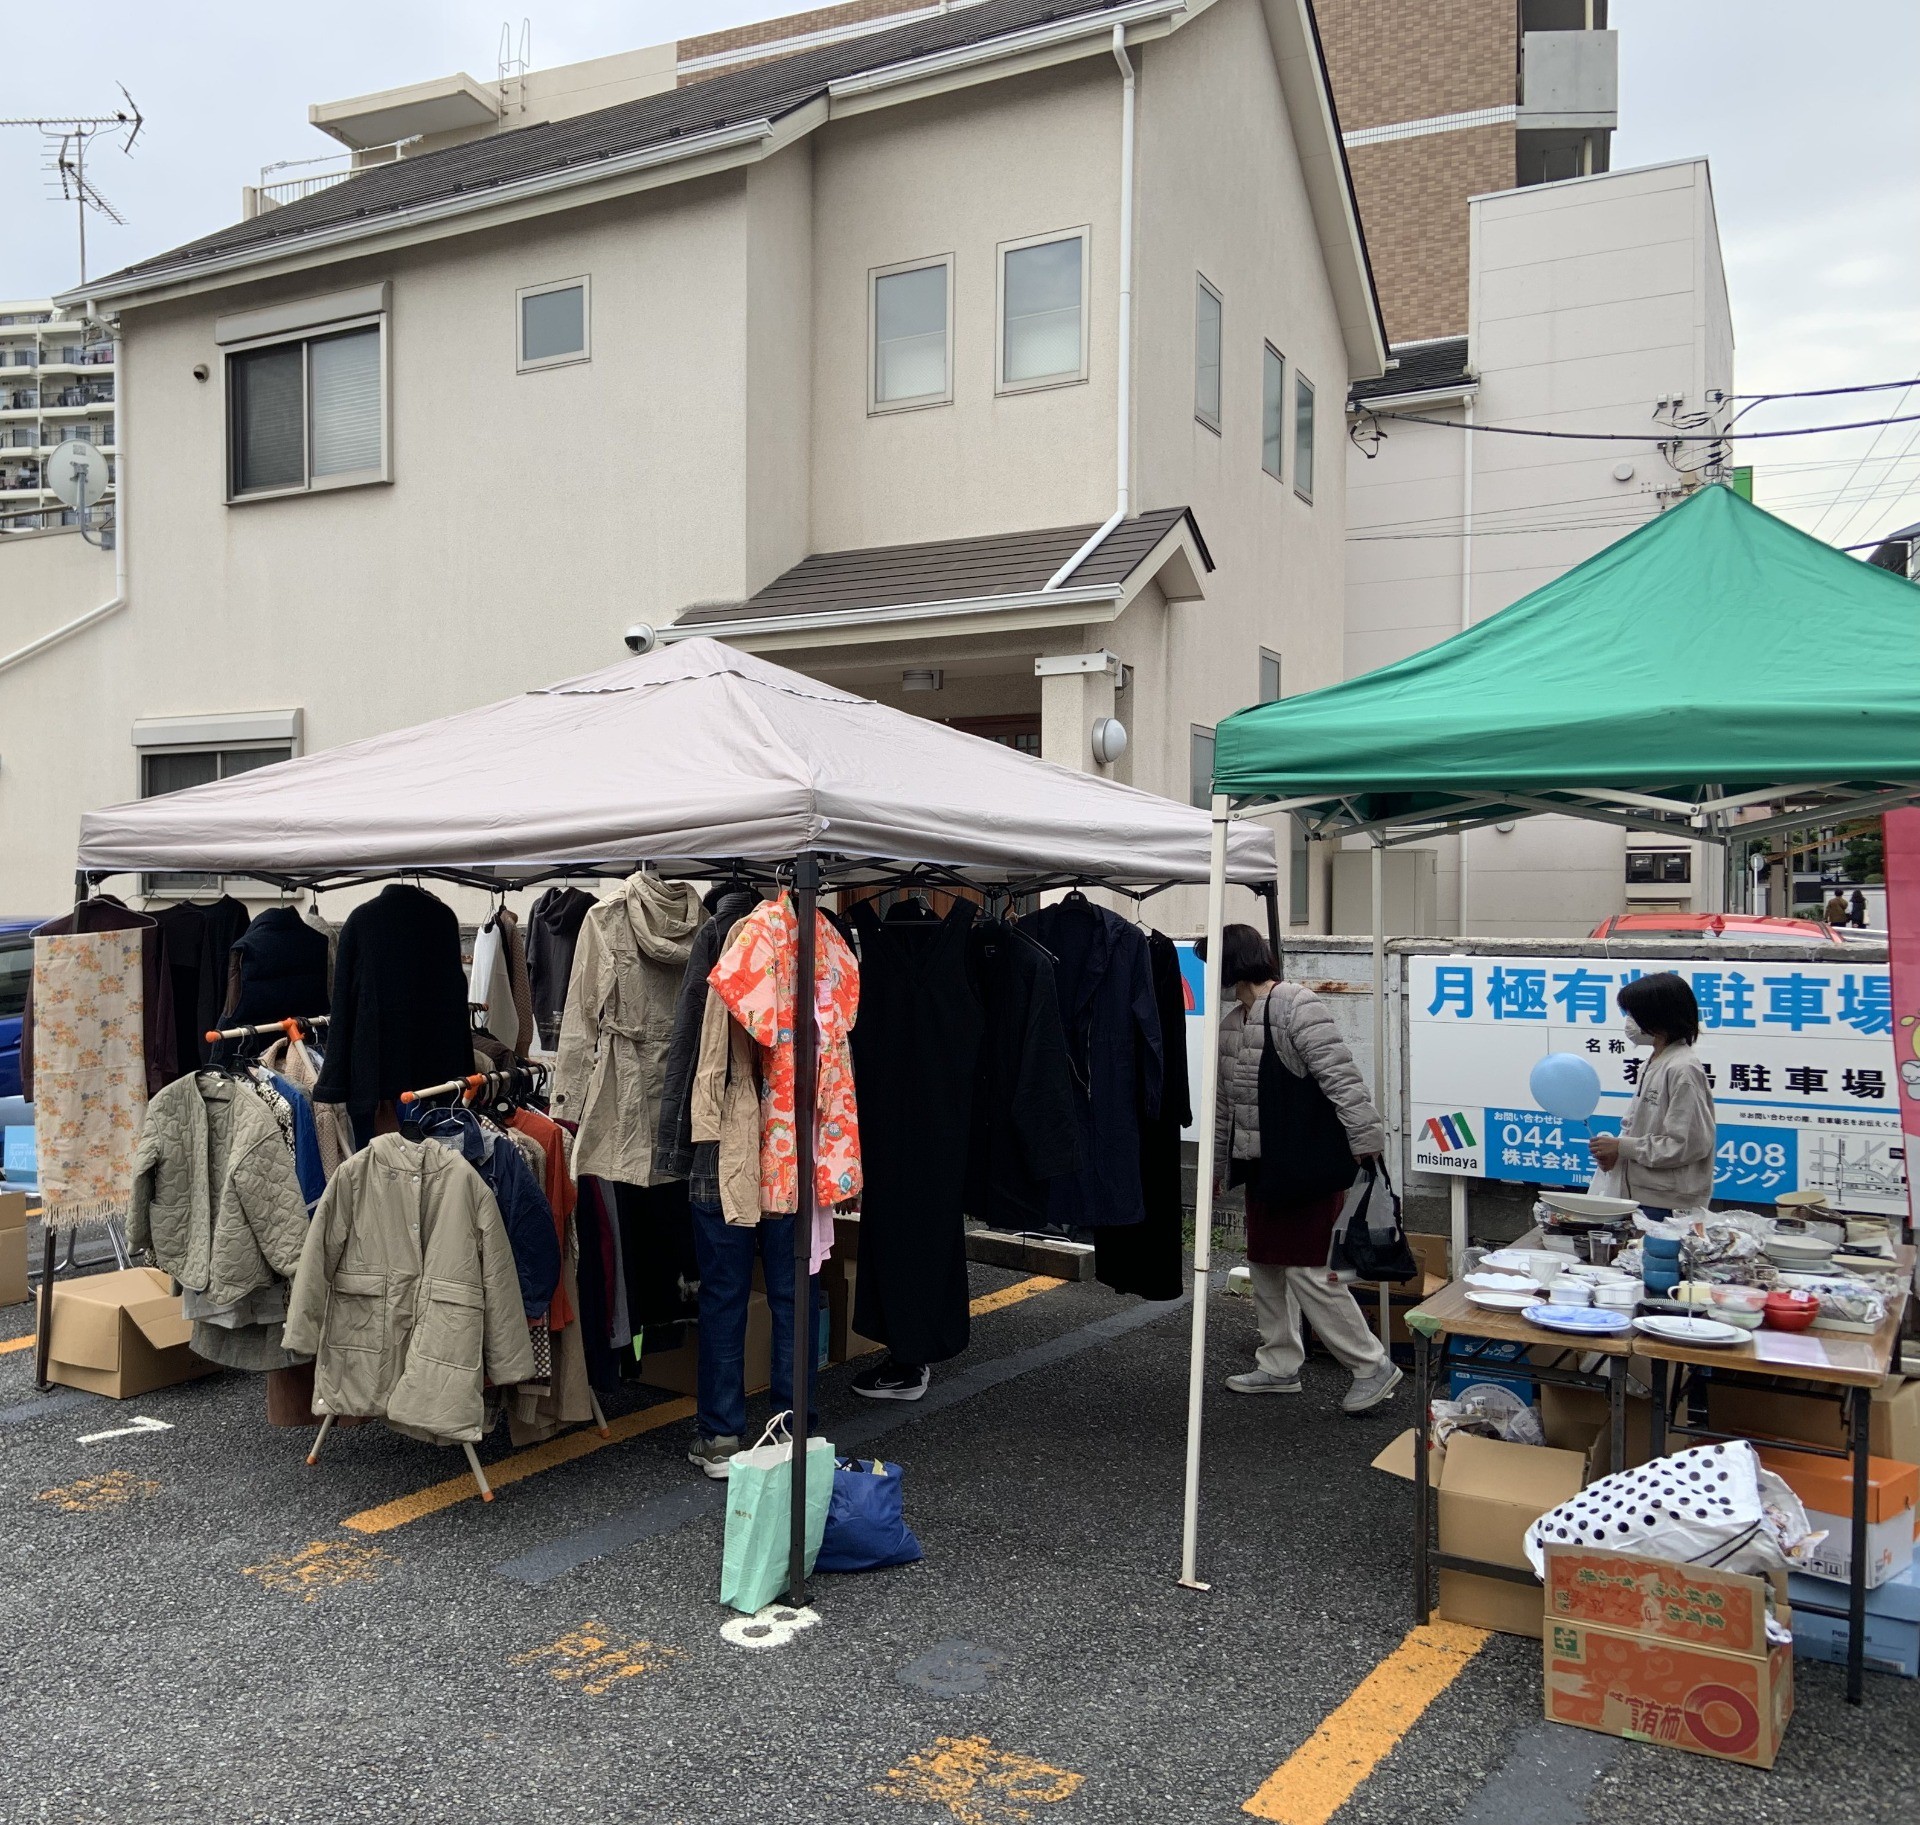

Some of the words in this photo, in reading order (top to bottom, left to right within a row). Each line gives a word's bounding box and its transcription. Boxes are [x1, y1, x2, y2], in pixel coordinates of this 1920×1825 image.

[1427, 966, 1893, 1035] 月極有駐車場
[1585, 1037, 1626, 1054] 名称
[1494, 1111, 1564, 1125] お問い合わせは
[1416, 1152, 1478, 1169] misimaya
[719, 1604, 822, 1648] 8
